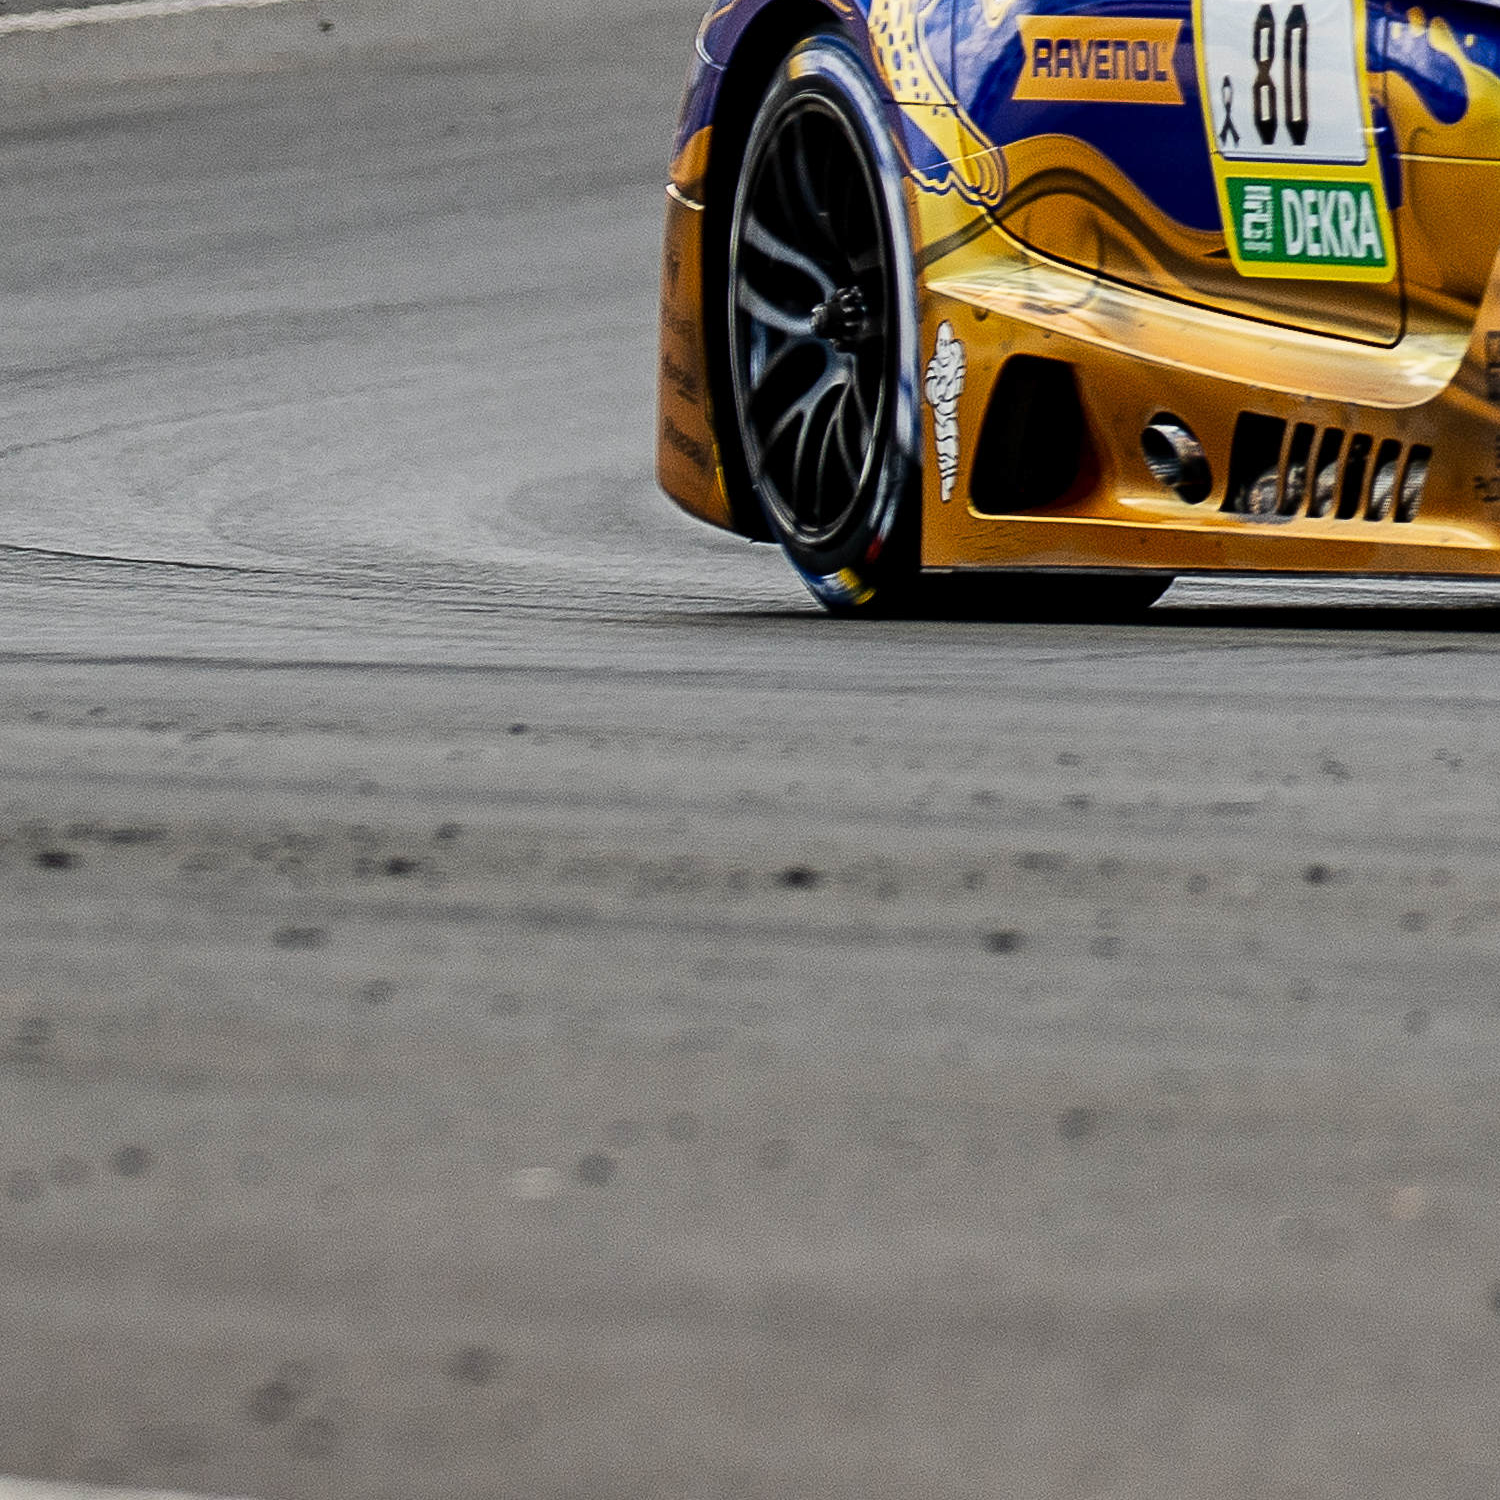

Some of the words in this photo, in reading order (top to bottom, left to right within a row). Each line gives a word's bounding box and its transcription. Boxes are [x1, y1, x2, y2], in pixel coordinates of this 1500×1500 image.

[1031, 38, 1168, 82] RAVENOL
[1252, 3, 1309, 146] 80
[1280, 188, 1384, 260] DEKRA
